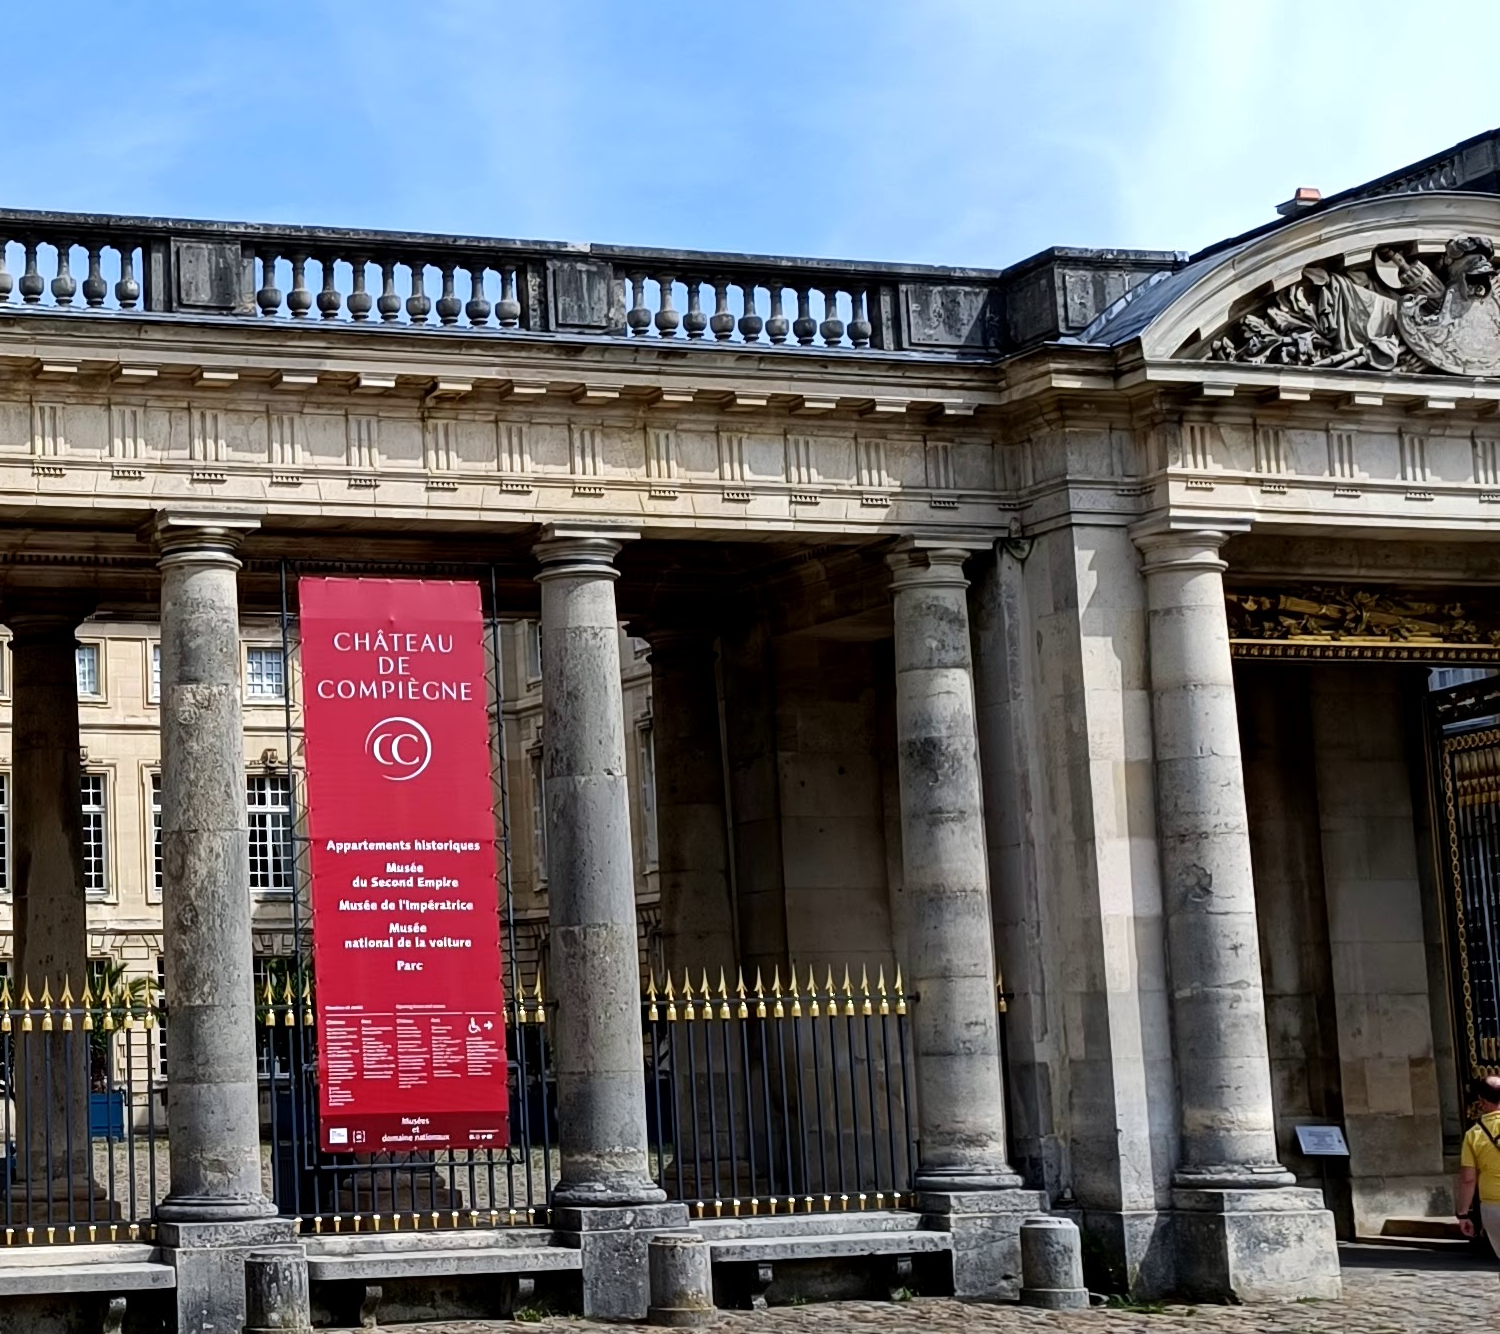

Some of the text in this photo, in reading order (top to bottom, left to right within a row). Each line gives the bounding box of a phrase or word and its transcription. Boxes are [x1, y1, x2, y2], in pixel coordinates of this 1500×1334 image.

[333, 629, 453, 653] CHÂTEAU
[378, 656, 410, 675] DE
[317, 677, 473, 701] COMPIÈGNE
[326, 839, 481, 853] Appartements historiques
[386, 862, 424, 873] Musée
[352, 876, 459, 890] du Second Empire
[339, 898, 474, 913] Musée de l'Impératrice
[389, 922, 428, 933] Musée
[344, 936, 472, 948] national de la voiture
[396, 960, 424, 971] Parc
